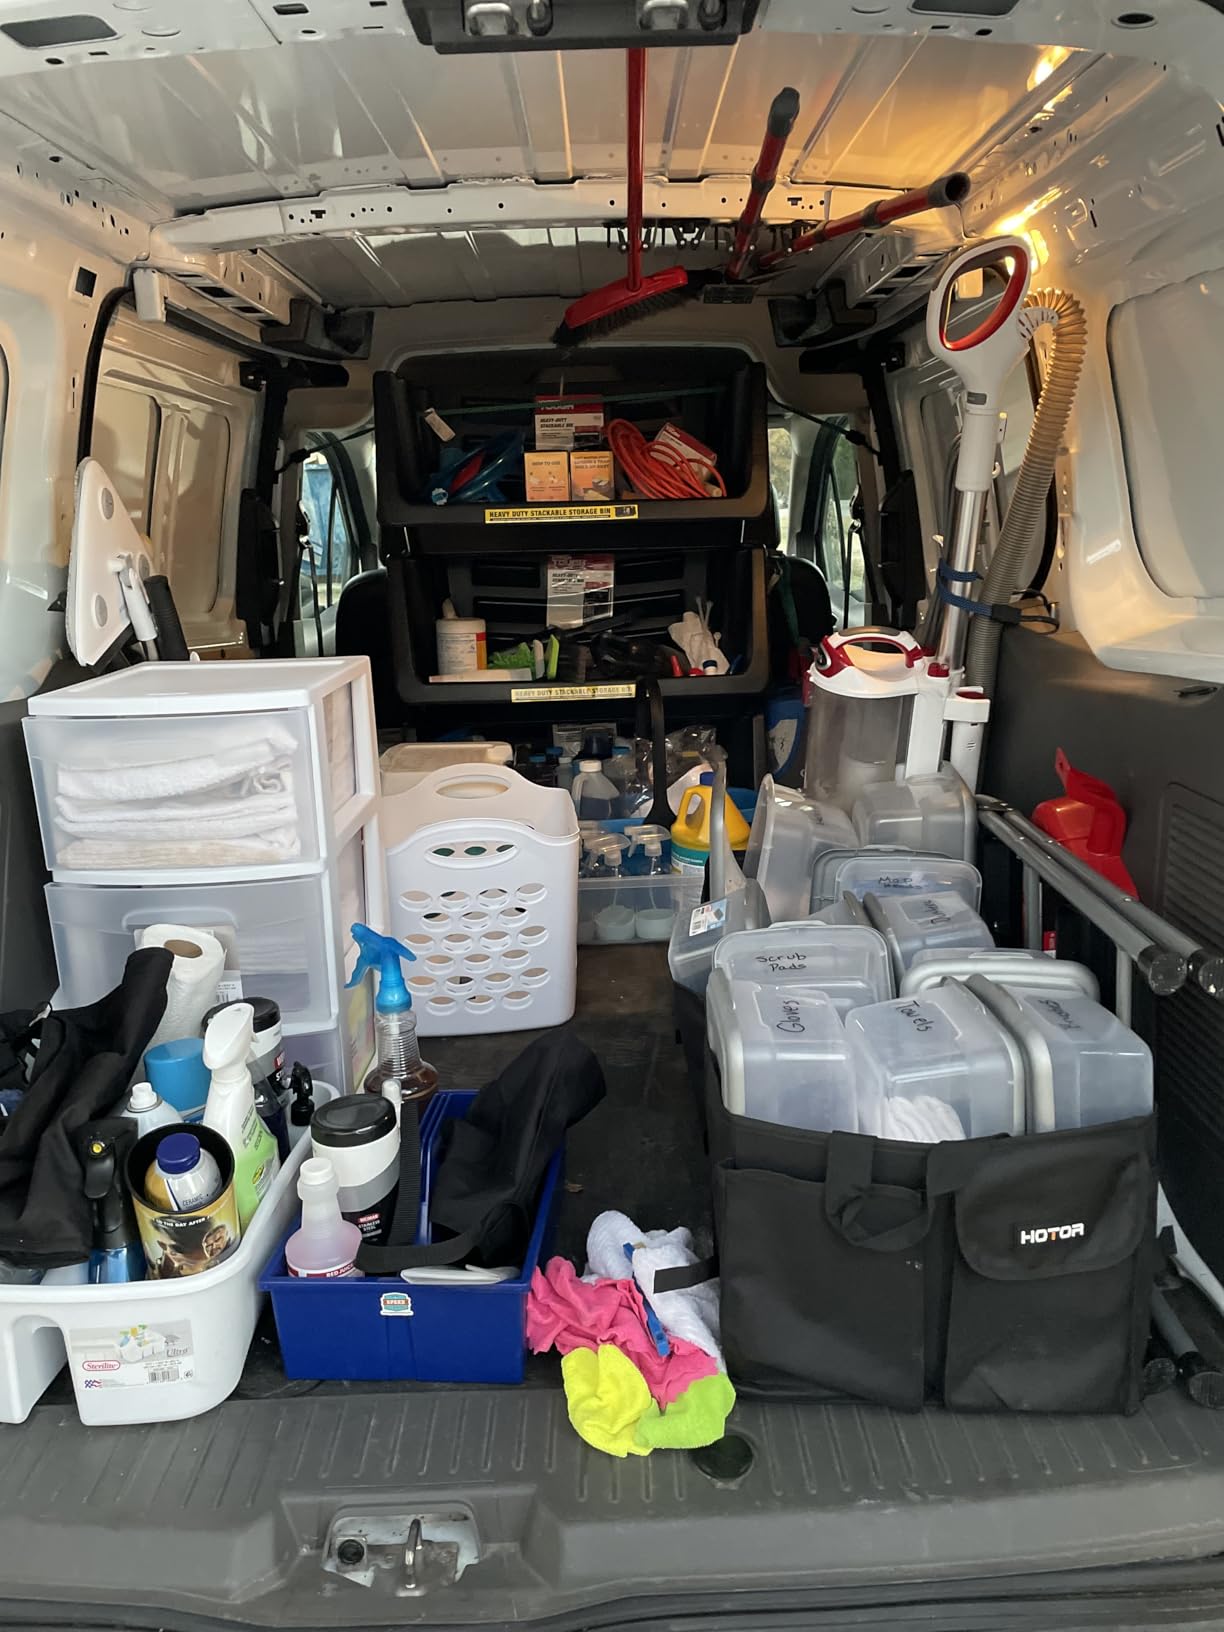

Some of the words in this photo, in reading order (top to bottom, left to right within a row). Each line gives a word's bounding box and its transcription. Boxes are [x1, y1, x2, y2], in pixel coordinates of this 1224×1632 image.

[530, 509, 567, 517] STACKABLE
[569, 508, 598, 516] STORAGE
[599, 507, 611, 515] BIN
[769, 962, 807, 972] Pads
[776, 1000, 806, 1033] Gloves
[895, 1000, 934, 1032] Towels
[188, 1217, 206, 1227] AFTER
[1020, 1222, 1085, 1245] HOTOR
[325, 1269, 339, 1278] RED
[86, 1362, 118, 1370] Sterilite
